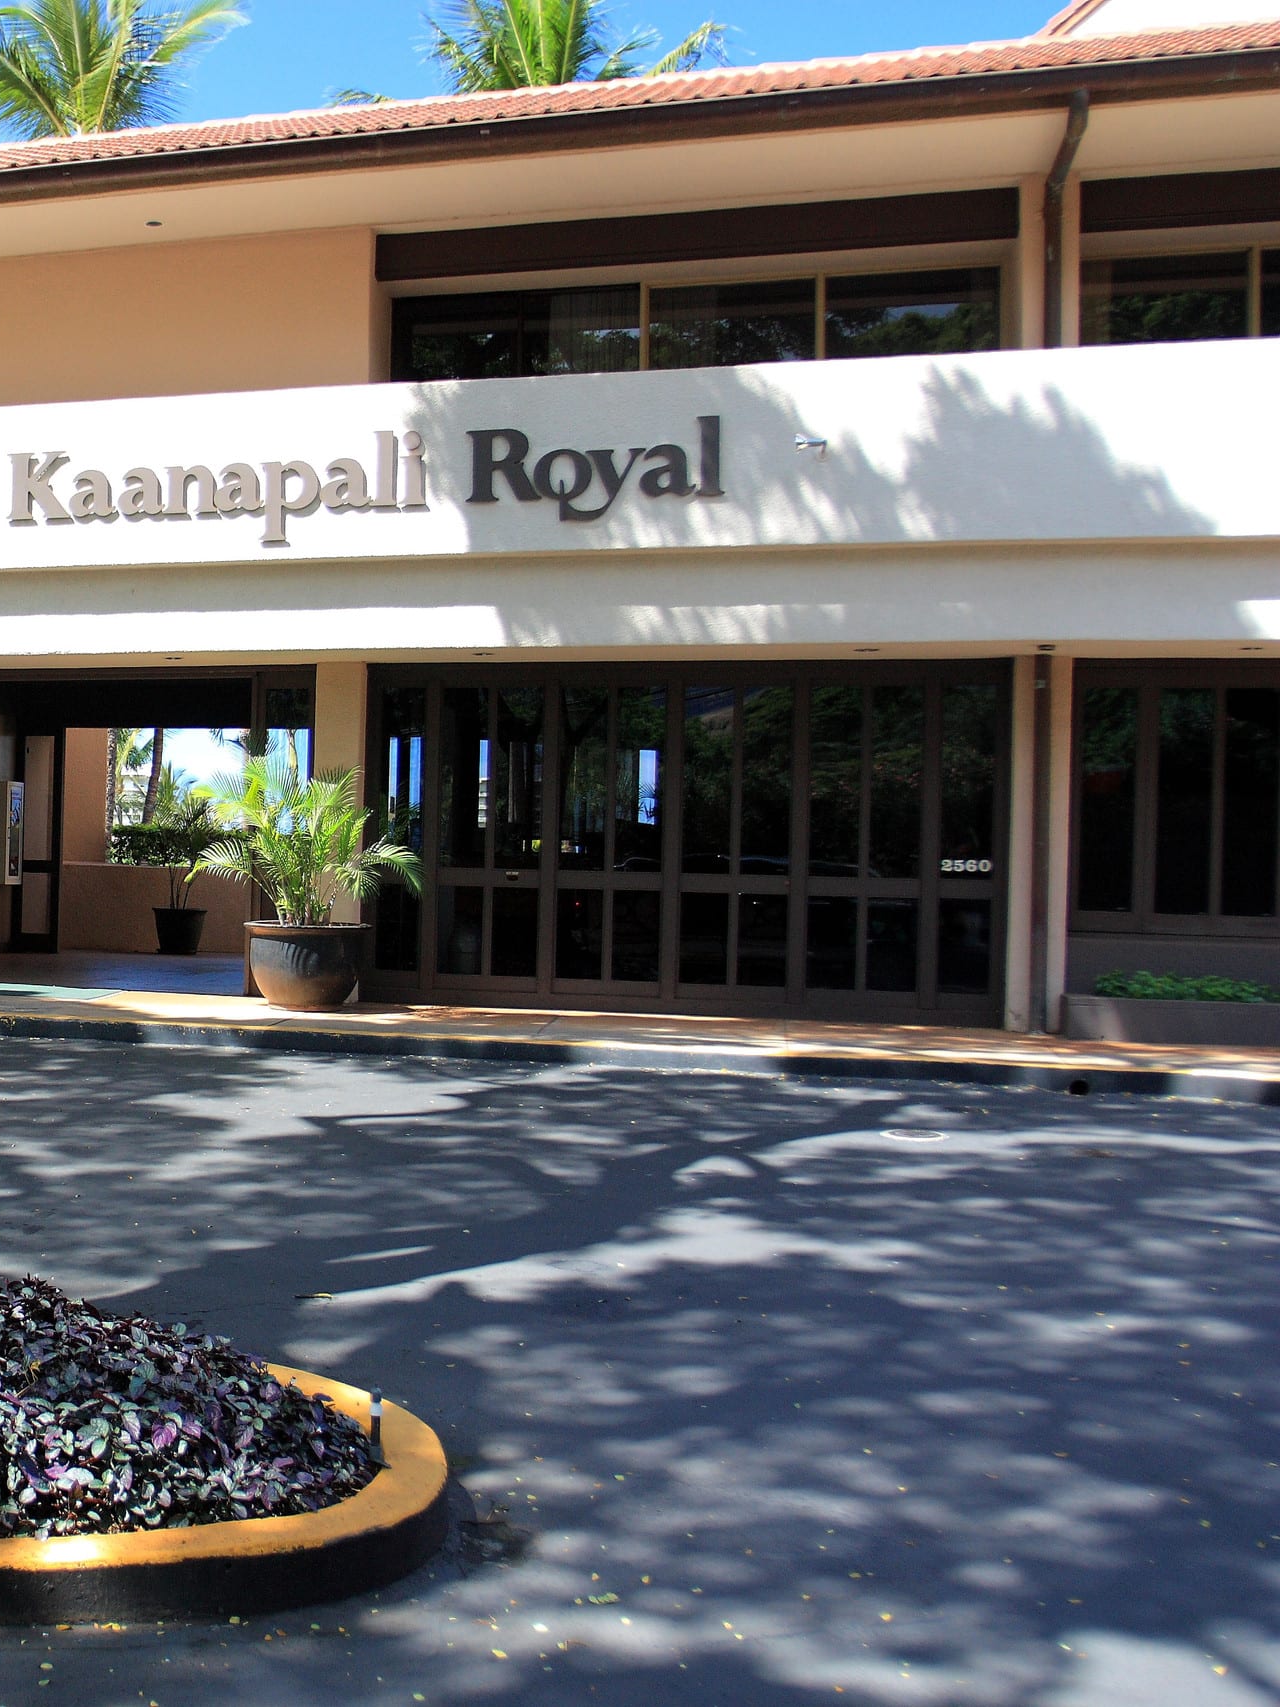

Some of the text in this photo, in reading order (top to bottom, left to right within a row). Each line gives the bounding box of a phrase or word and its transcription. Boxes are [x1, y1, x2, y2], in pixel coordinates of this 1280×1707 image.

[7, 415, 725, 543] Kaanapali Royal
[940, 859, 992, 872] 2560
